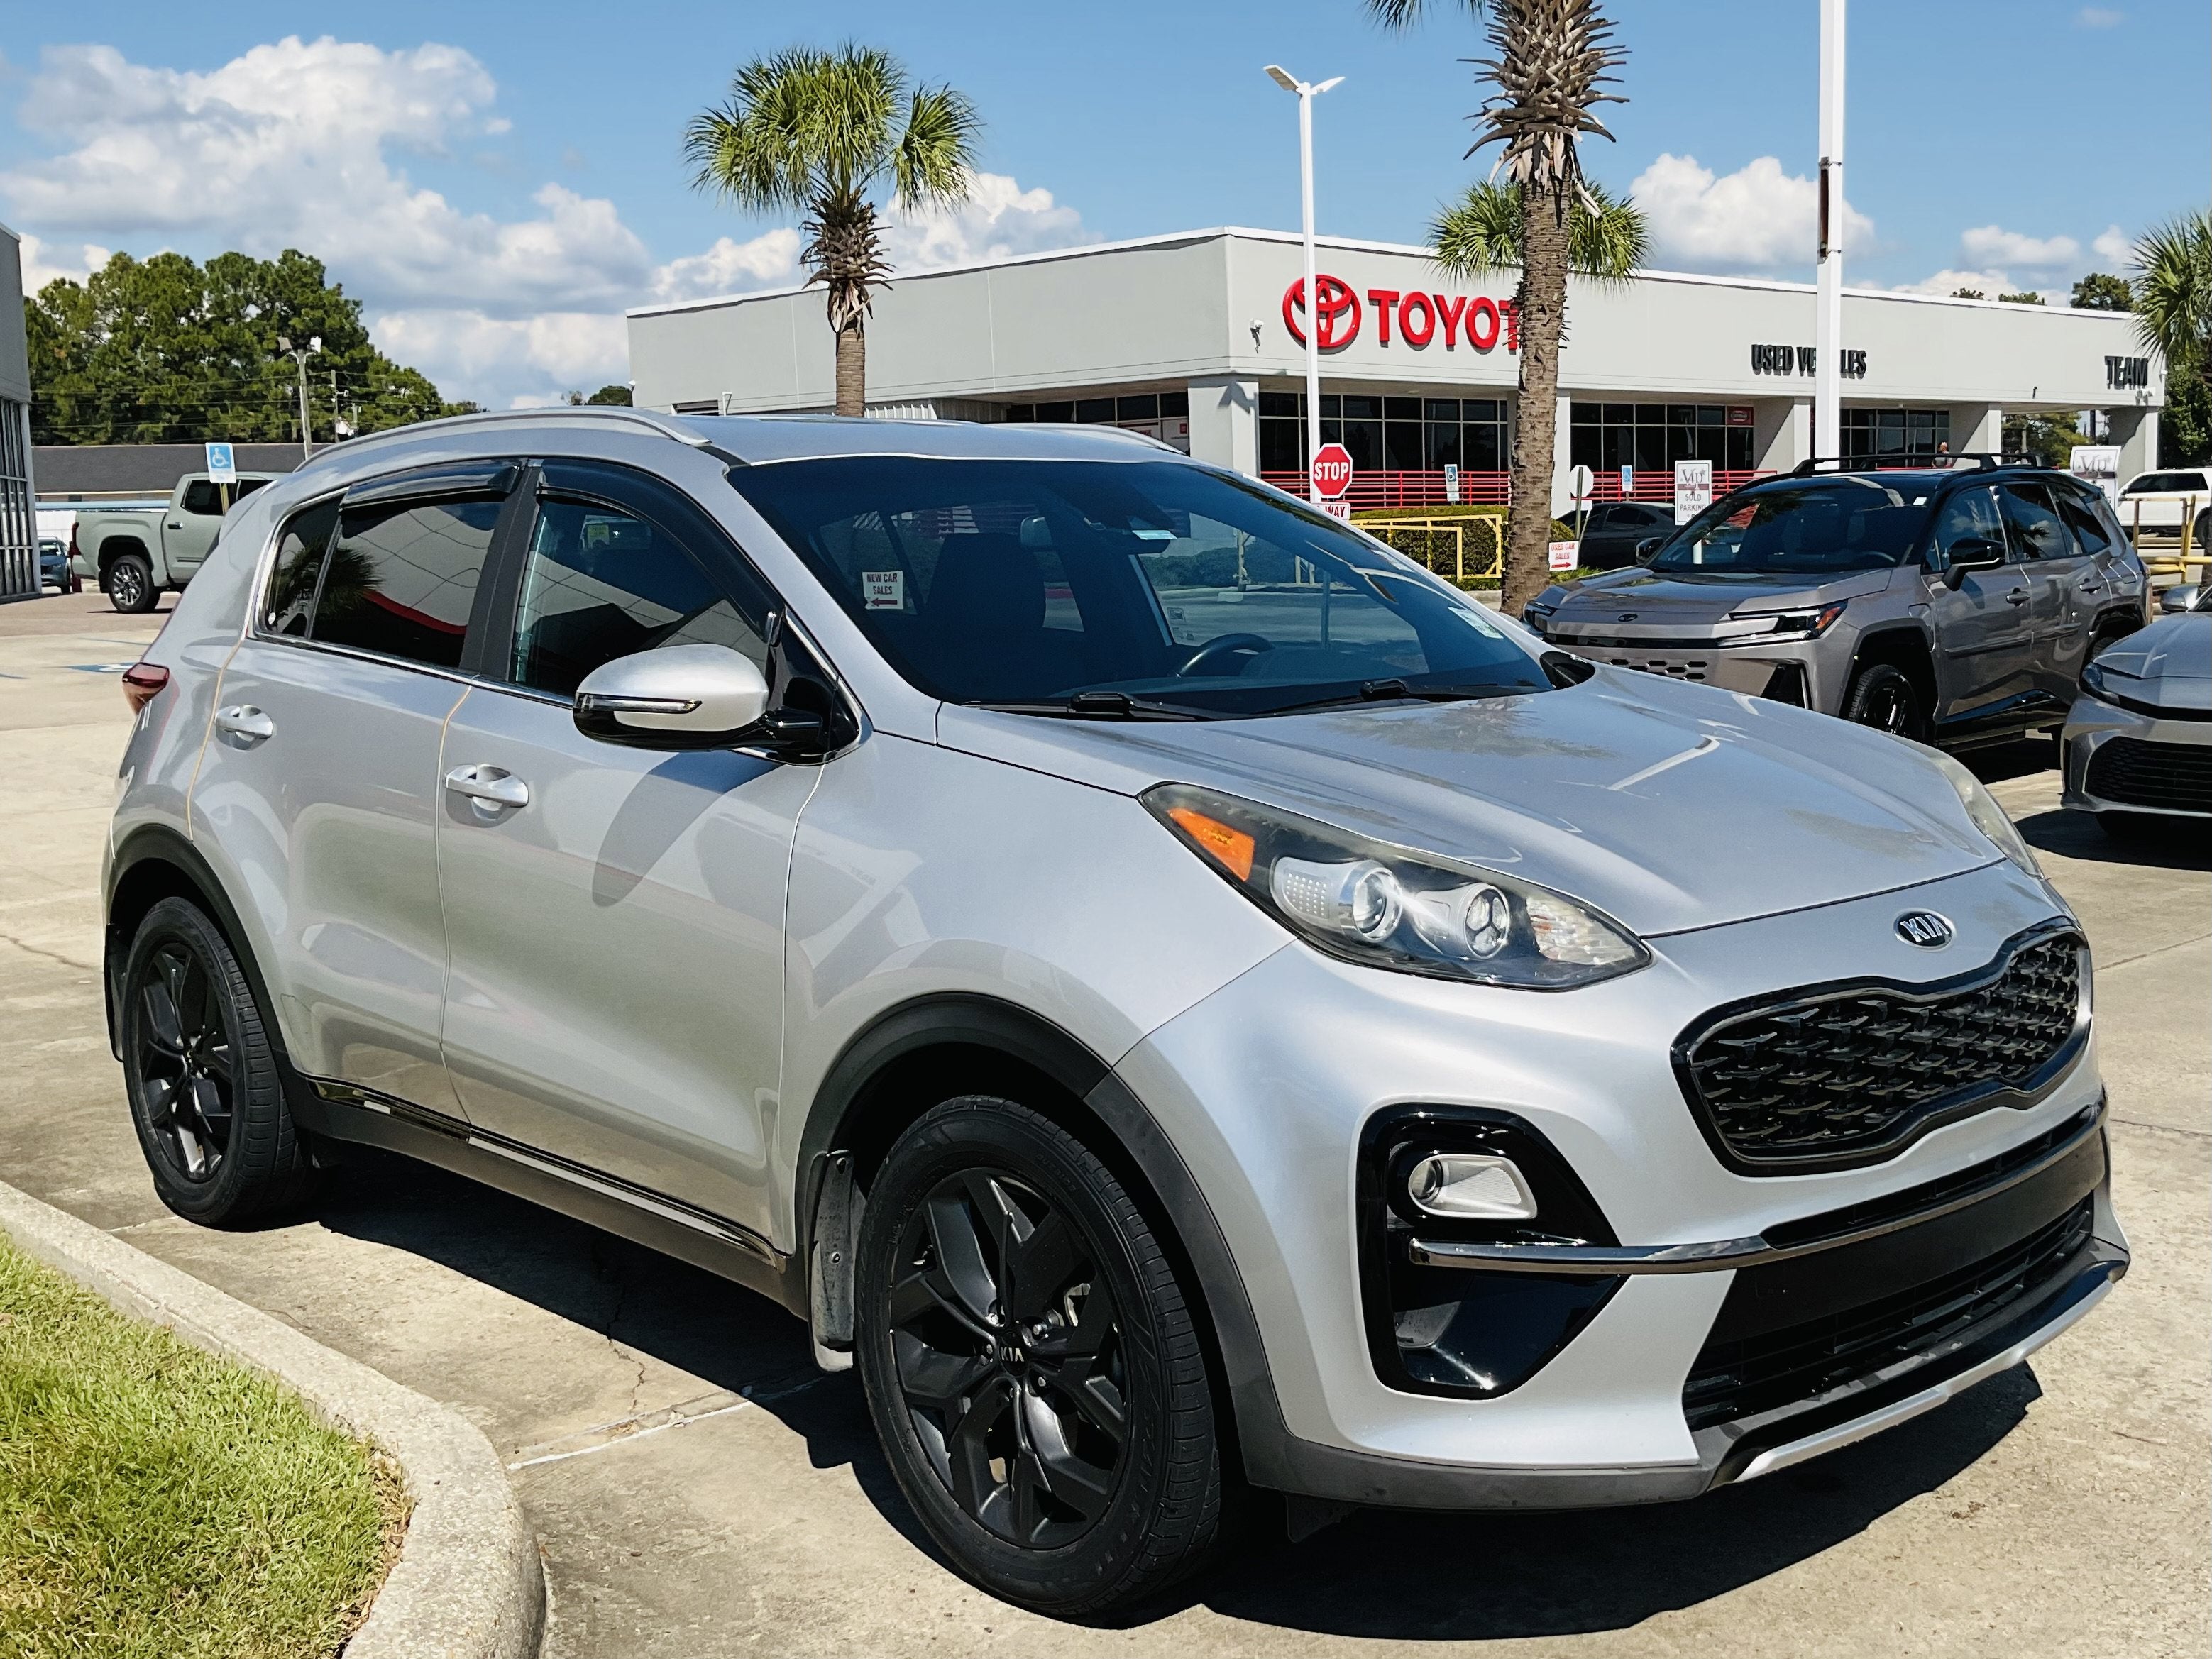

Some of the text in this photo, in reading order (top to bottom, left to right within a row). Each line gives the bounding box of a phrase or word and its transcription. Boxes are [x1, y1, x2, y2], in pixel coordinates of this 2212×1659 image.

[1368, 289, 1519, 351] TOYOT
[1751, 344, 1867, 374] USED VELES
[2104, 356, 2148, 386] TEAM
[1314, 462, 1349, 480] STOP
[1685, 493, 1702, 502] SOLD
[1325, 505, 1345, 517] WAY
[866, 573, 897, 583] NEW CAR
[873, 585, 892, 595] SALES
[1900, 915, 1949, 942] KIA
[1000, 1347, 1025, 1362] KIA
